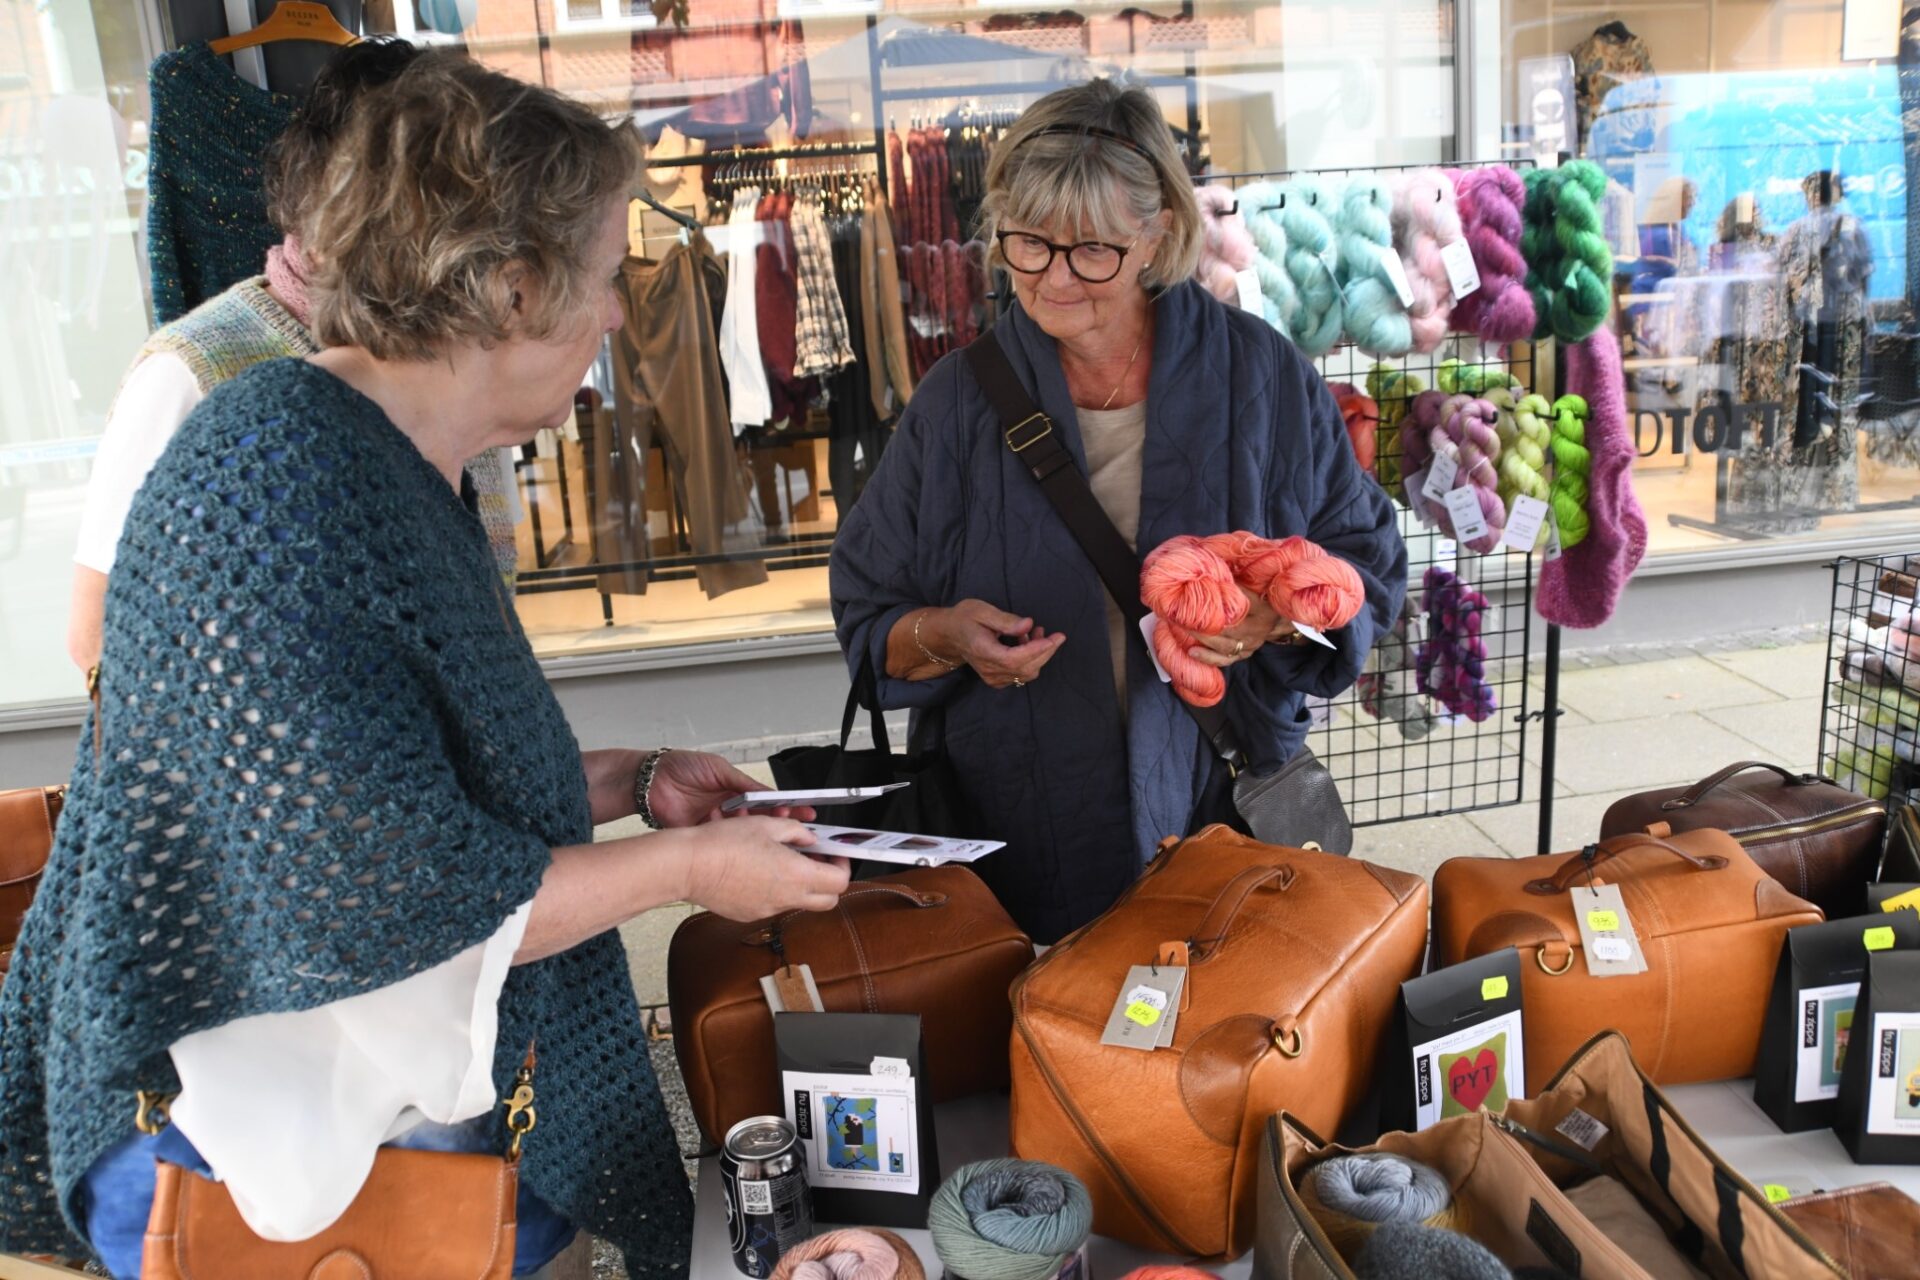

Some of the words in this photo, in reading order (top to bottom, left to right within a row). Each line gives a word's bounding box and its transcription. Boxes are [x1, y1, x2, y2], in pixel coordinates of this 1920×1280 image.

[1807, 1002, 1816, 1015] fru
[1806, 1016, 1816, 1044] zippe
[1884, 1031, 1895, 1044] fru
[1420, 1058, 1428, 1072] fru
[1881, 1045, 1893, 1074] zippe
[1420, 1073, 1429, 1101] zippe
[1453, 1065, 1493, 1094] PYT
[798, 1093, 808, 1106] fru
[798, 1107, 809, 1133] zippe
